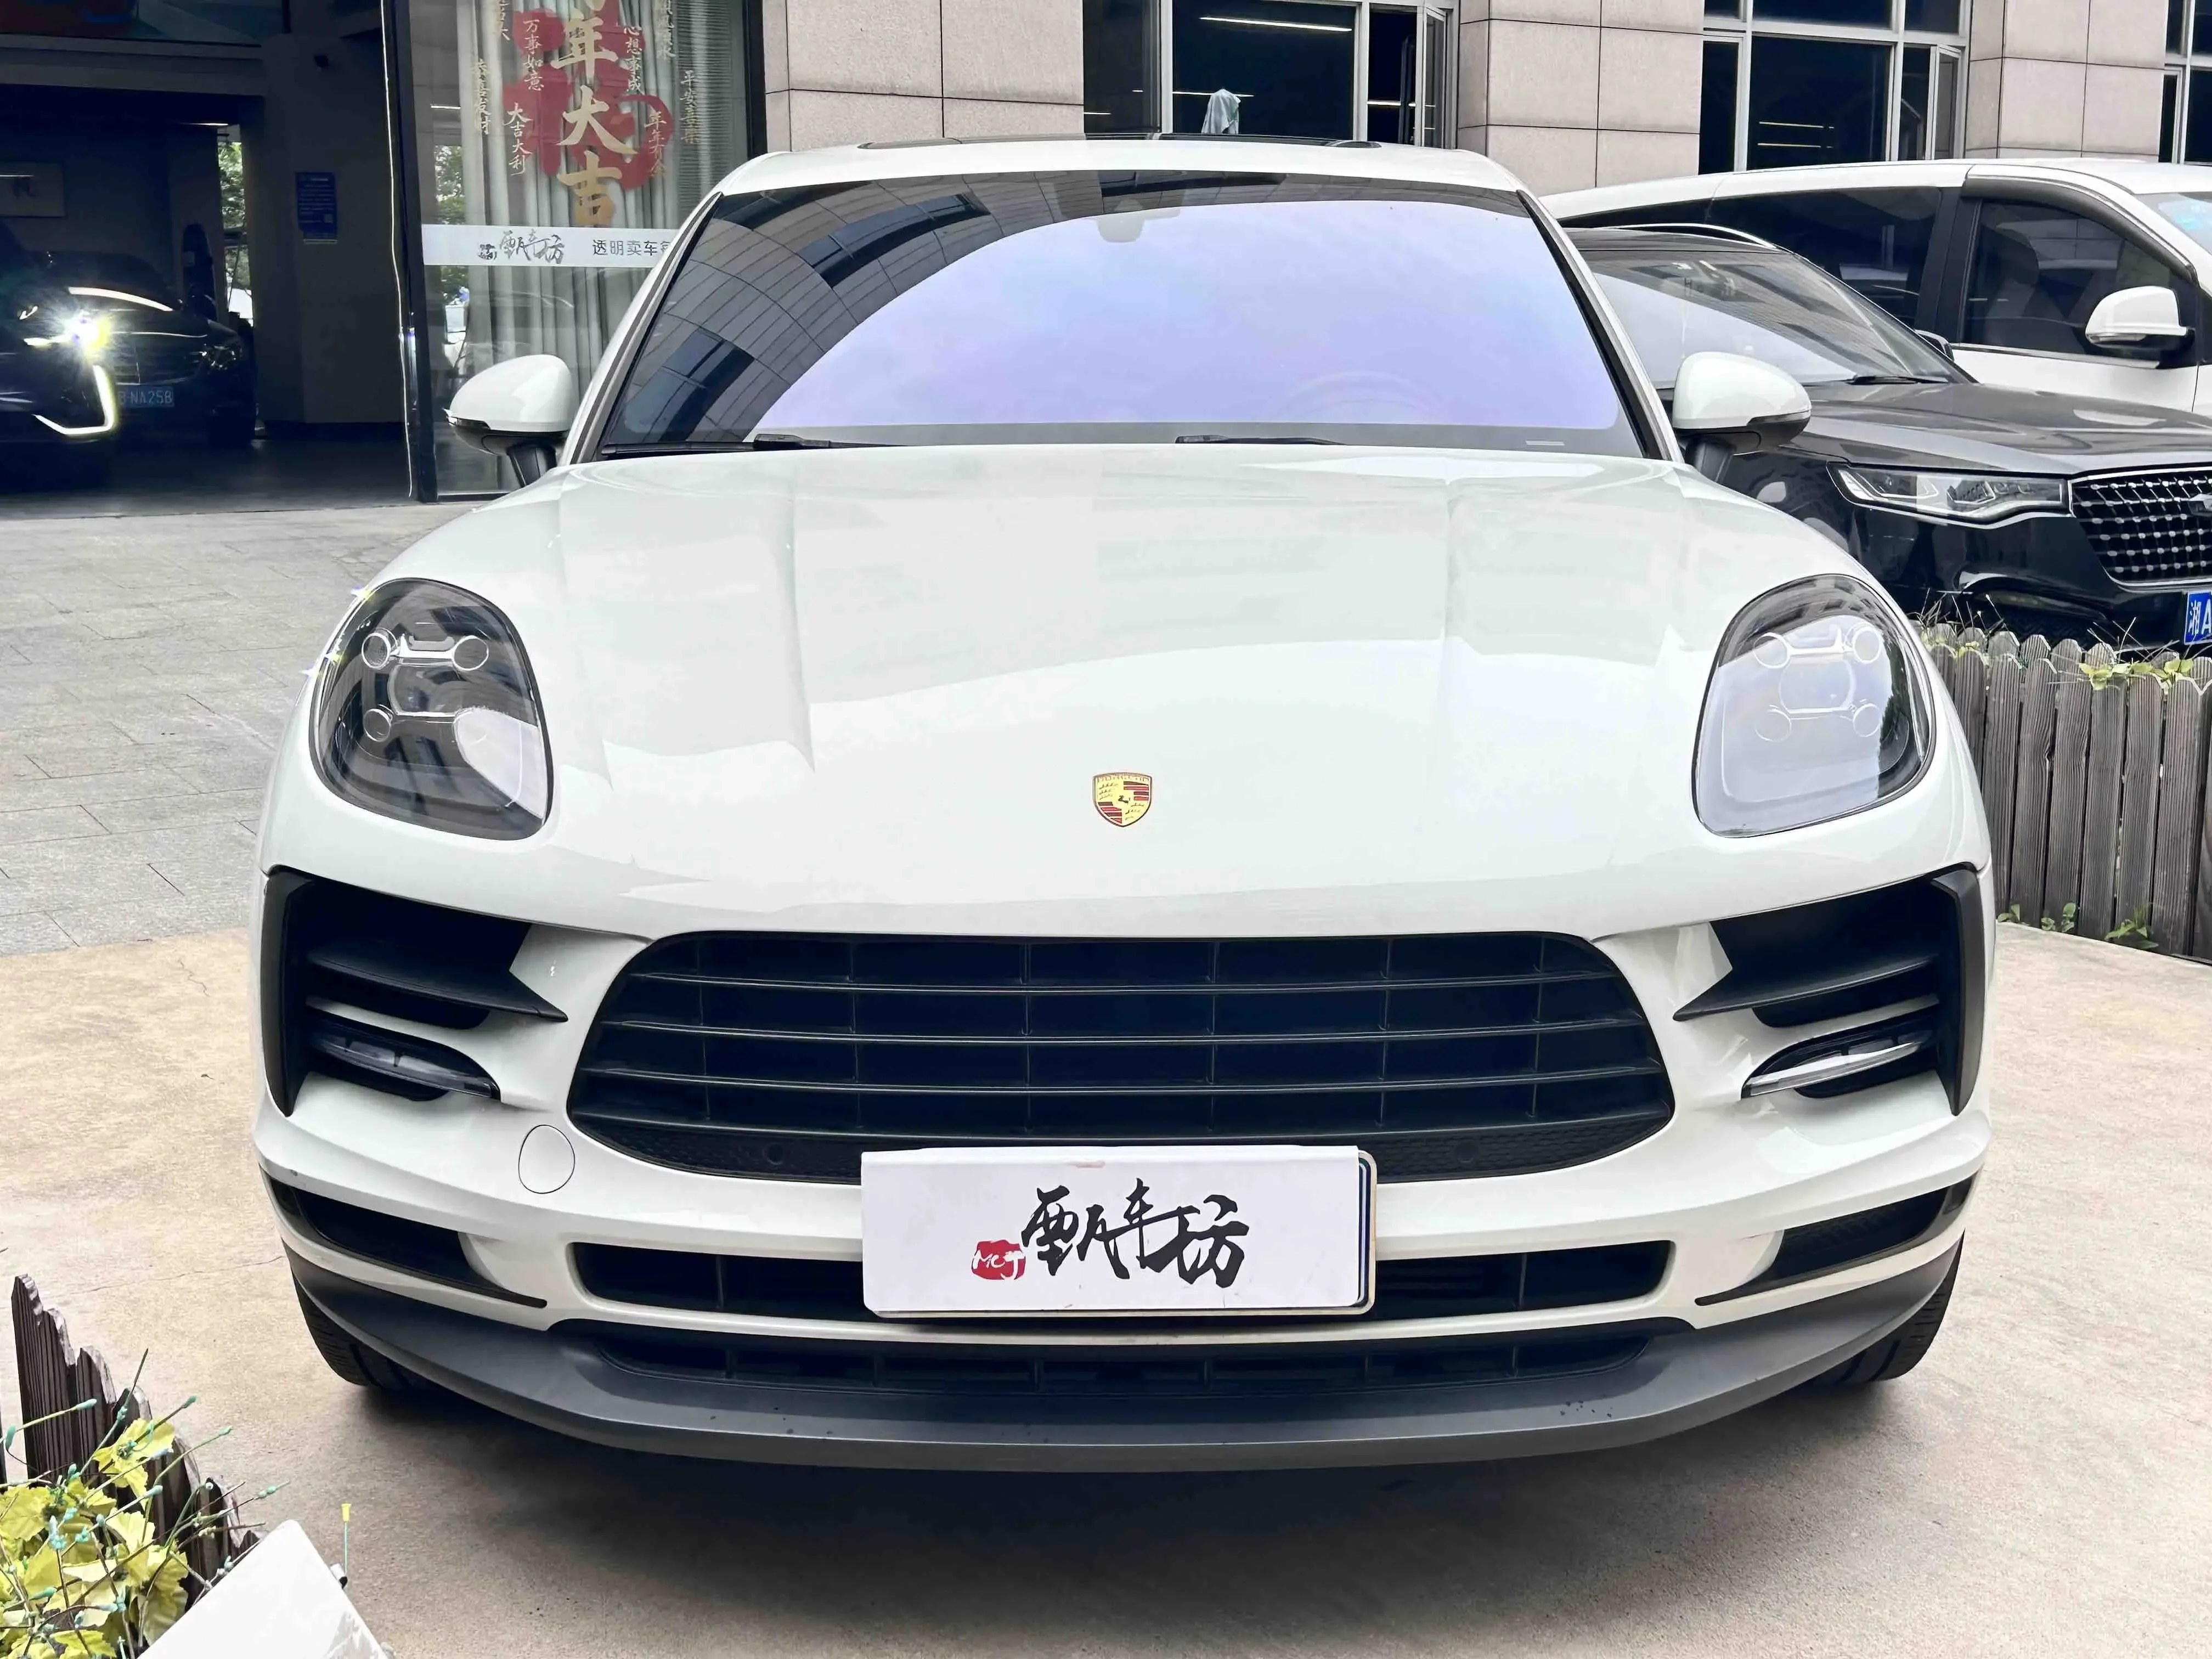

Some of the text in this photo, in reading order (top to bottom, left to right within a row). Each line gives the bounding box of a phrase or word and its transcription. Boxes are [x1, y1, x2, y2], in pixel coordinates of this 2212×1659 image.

[523, 19, 545, 91] 万事如意
[623, 26, 646, 96] 心想事成
[502, 101, 534, 176] 大吉大利
[550, 0, 639, 223] 年大吉
